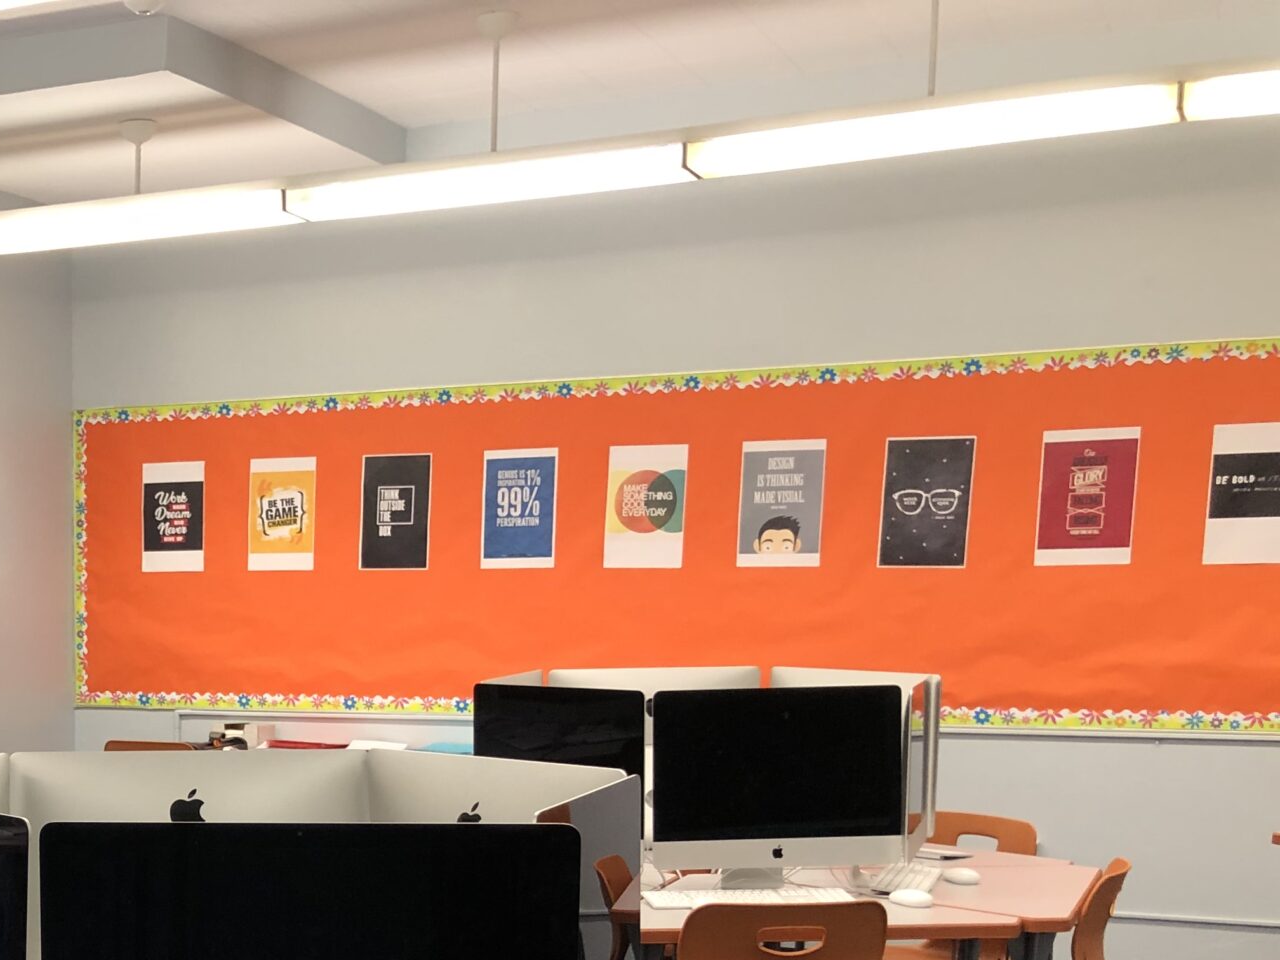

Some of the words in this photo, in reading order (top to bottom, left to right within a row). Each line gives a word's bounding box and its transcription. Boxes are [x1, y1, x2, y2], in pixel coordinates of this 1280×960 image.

[768, 456, 795, 470] DESIGN
[526, 469, 541, 486] 1%
[757, 474, 764, 487] IS
[766, 473, 804, 487] THINKING
[1074, 468, 1104, 485] GLORY
[1216, 475, 1229, 485] BE
[1232, 474, 1256, 484] BOLD
[154, 491, 188, 506] Work
[381, 489, 400, 500] THINK
[623, 490, 673, 501] SOMETHING
[754, 491, 776, 504] MADE
[268, 499, 278, 508] BE
[280, 497, 295, 507] THE
[380, 500, 405, 511] OUTSIDE
[497, 486, 540, 517] 99%
[622, 500, 647, 509] COOL
[154, 506, 192, 521] Dream
[265, 506, 298, 520] GAME
[380, 511, 391, 522] THE
[622, 507, 667, 517] EVERYDAY
[267, 518, 297, 528] CHANGER
[496, 517, 540, 527] PERSPIRATION
[157, 522, 187, 536] Never
[379, 525, 391, 536] BOX
